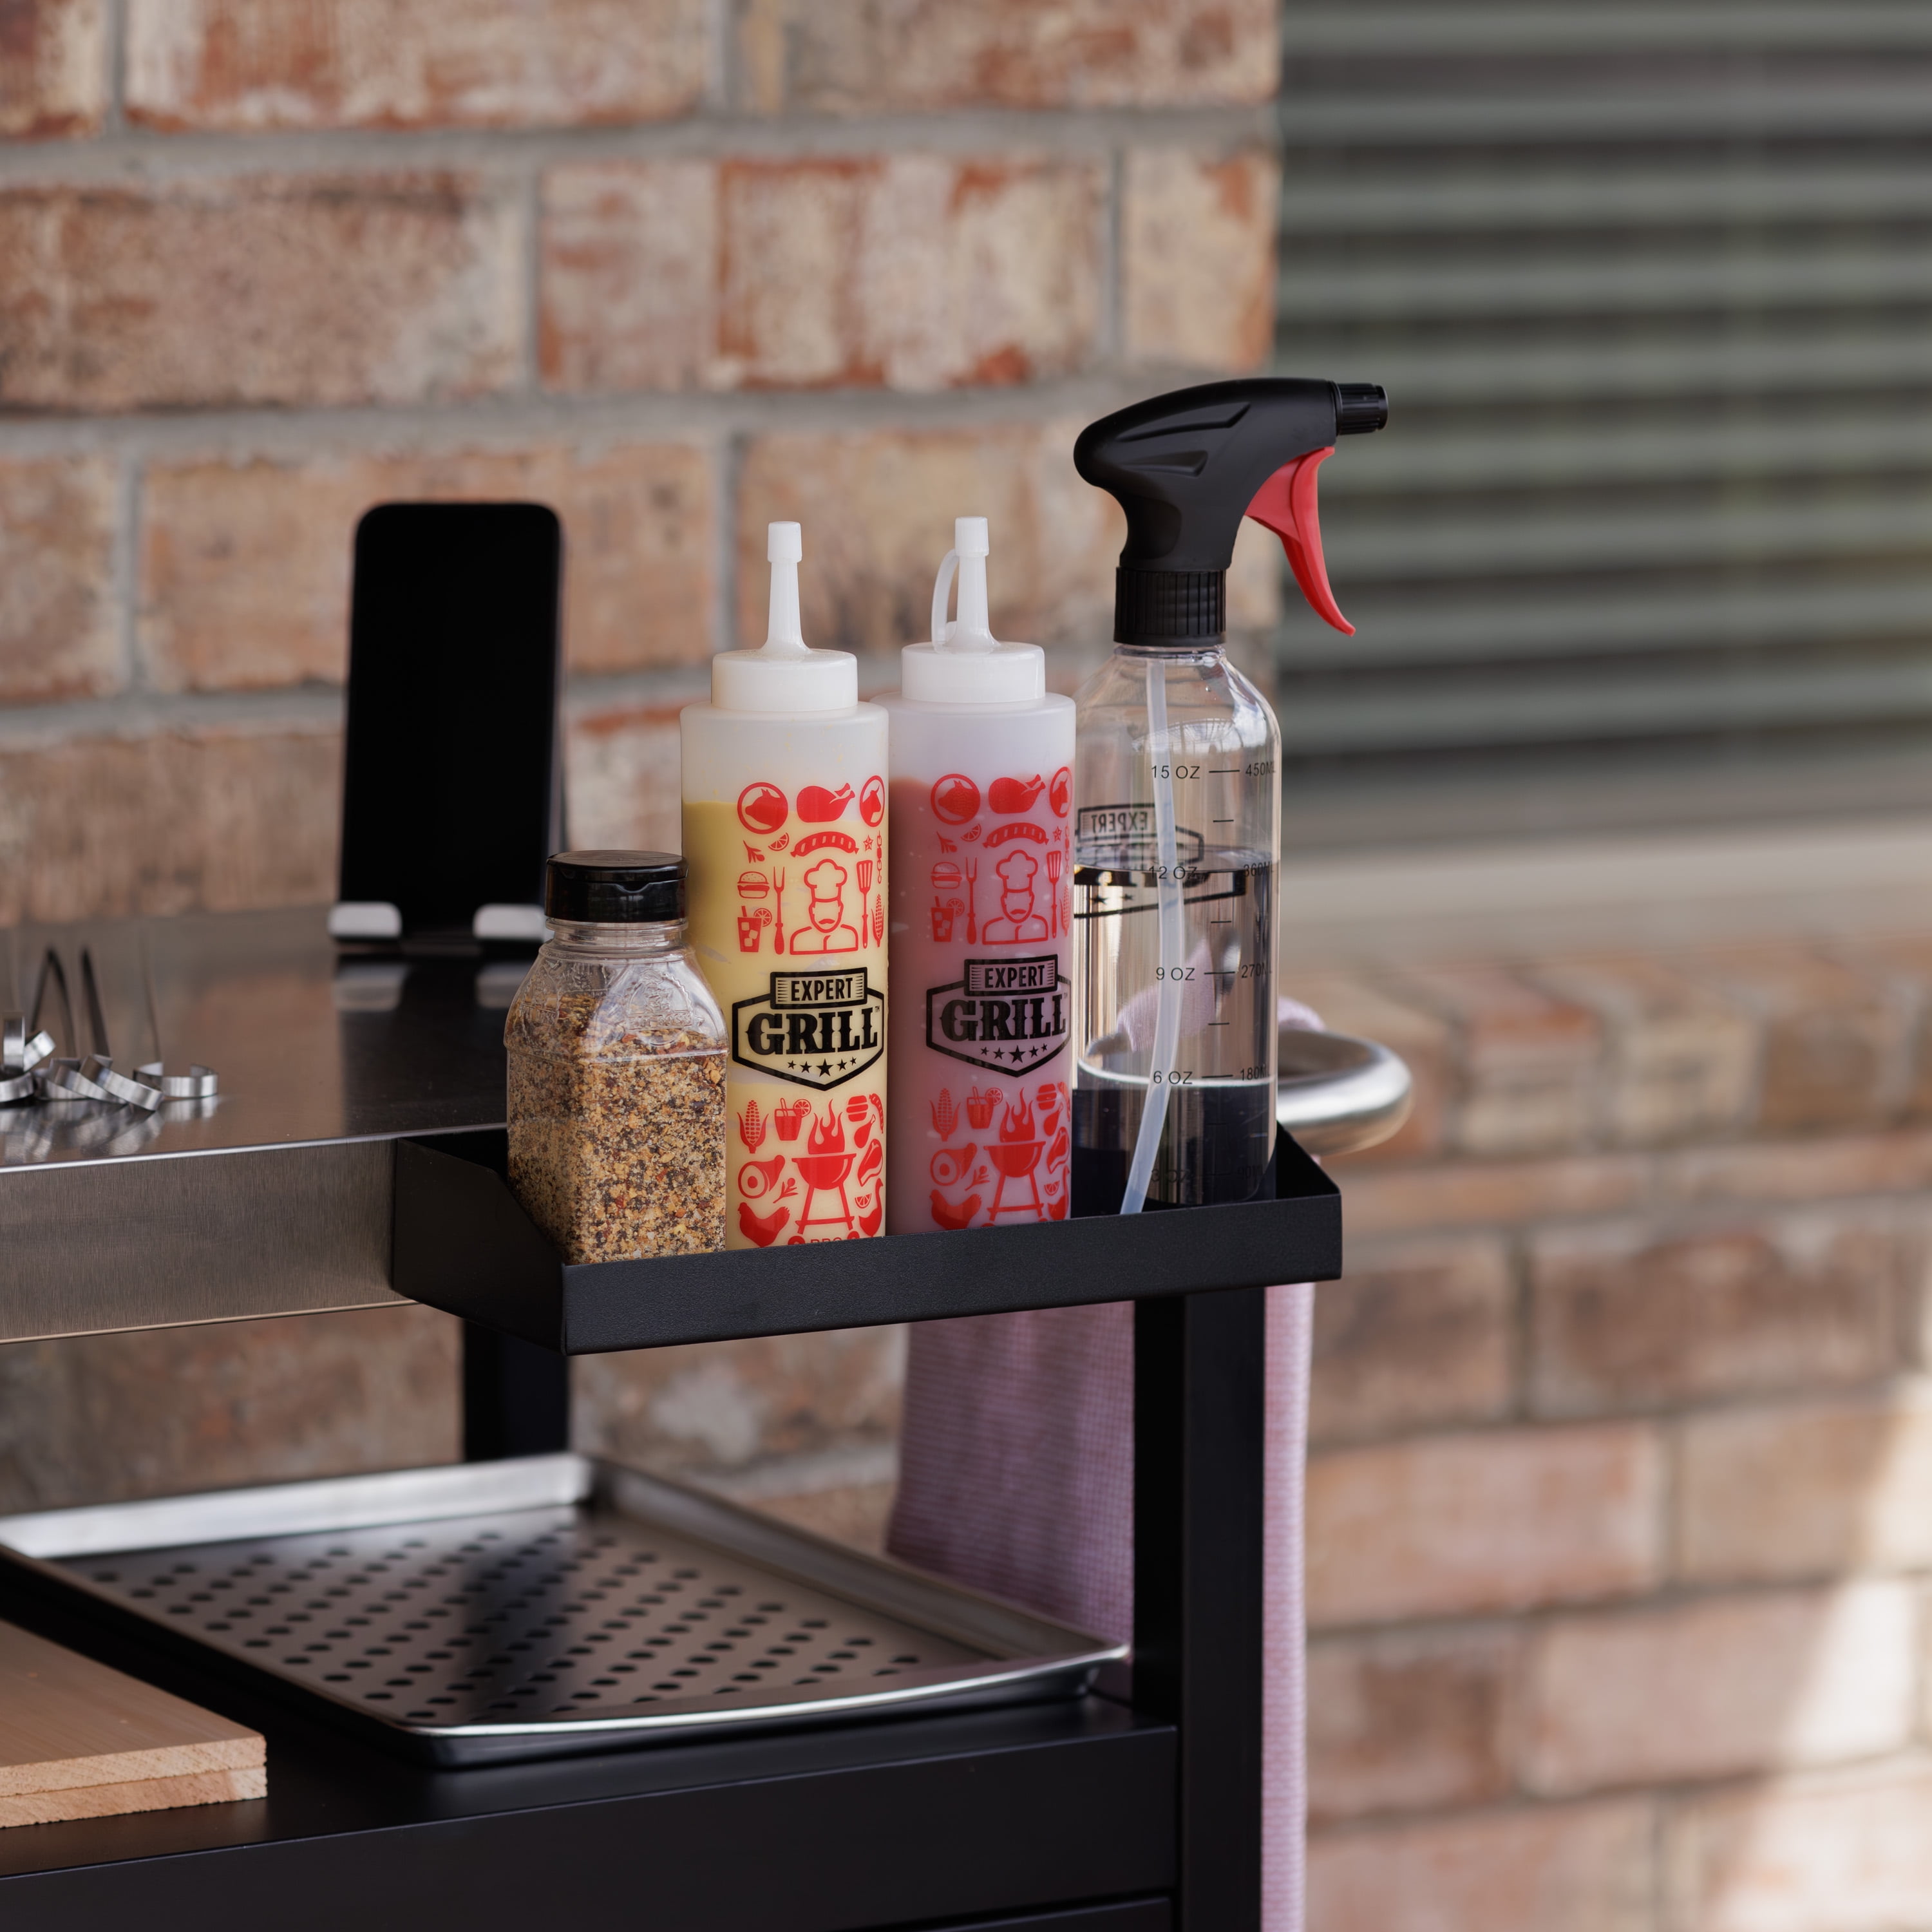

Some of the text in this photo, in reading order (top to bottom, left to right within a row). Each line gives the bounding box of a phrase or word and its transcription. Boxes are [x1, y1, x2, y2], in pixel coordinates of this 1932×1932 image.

[1151, 765, 1170, 779] 15
[1175, 765, 1200, 779] OZ
[1149, 865, 1167, 880] 12
[1173, 866, 1198, 880] OZ
[984, 964, 1045, 989] EXPERT
[1156, 967, 1165, 980] 9
[1171, 967, 1195, 981] OZ
[790, 977, 853, 1002] EXPERT
[938, 993, 1066, 1042] GRILL
[744, 1007, 878, 1056] GRILL
[1153, 1070, 1162, 1084] 6
[1168, 1071, 1193, 1084] OZ
